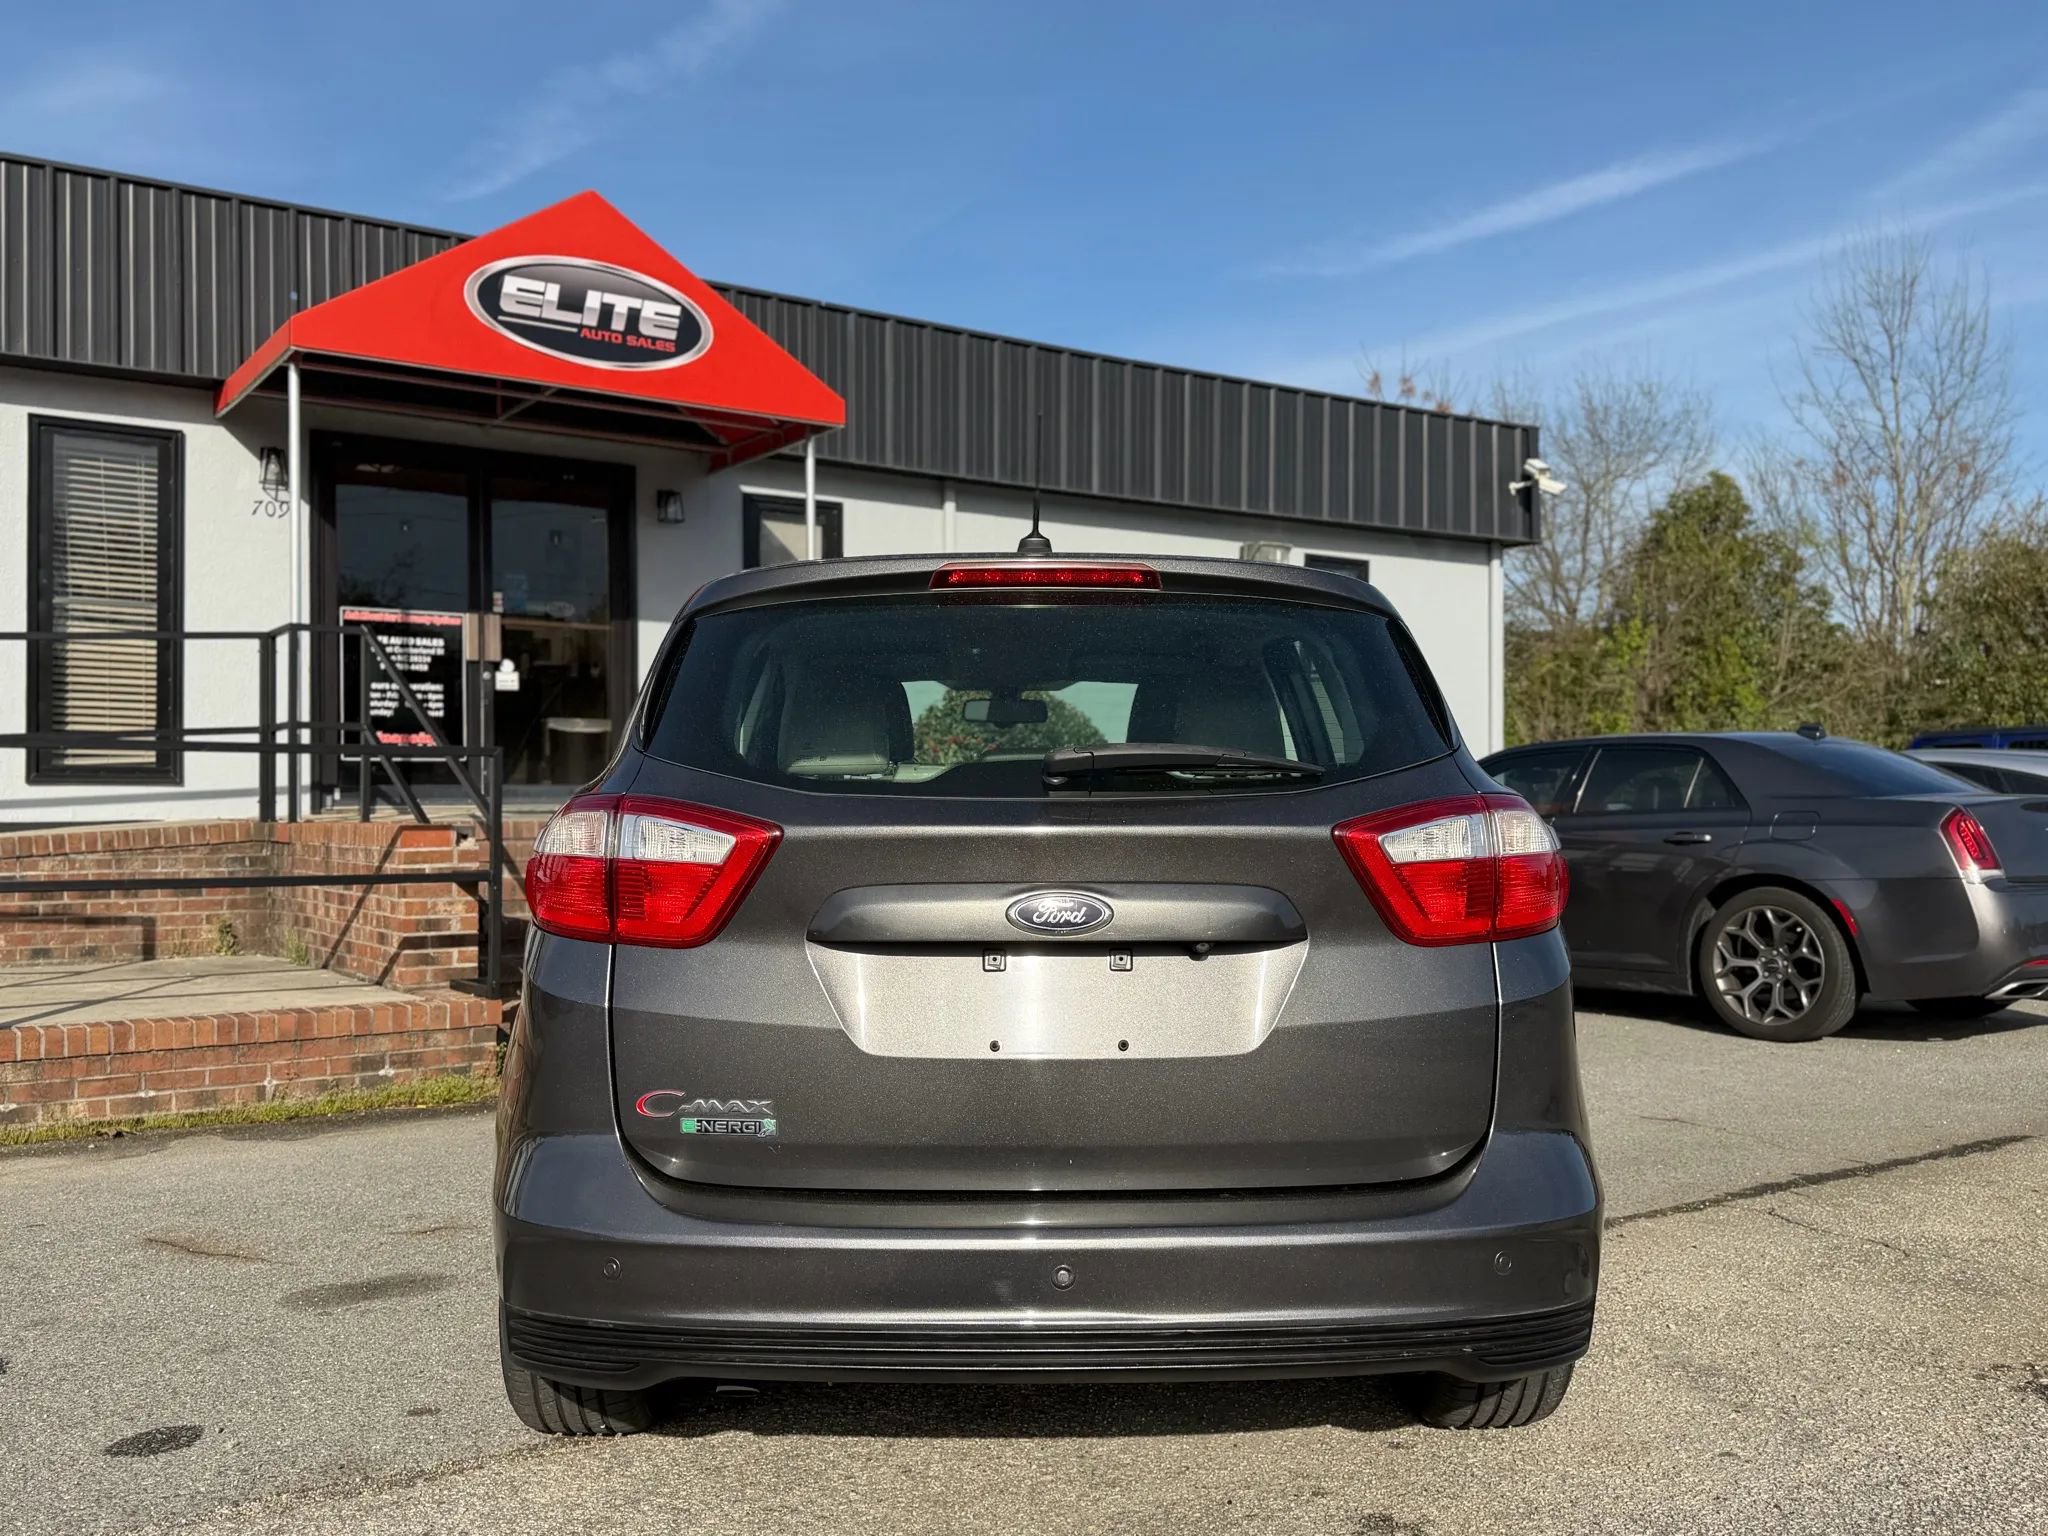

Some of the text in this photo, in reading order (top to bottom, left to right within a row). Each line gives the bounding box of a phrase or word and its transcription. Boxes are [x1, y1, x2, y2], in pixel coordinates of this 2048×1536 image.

[499, 274, 682, 340] ELITE
[580, 327, 676, 353] AUTO SALES
[252, 500, 290, 518] 709
[1033, 900, 1087, 924] Ford
[681, 1119, 761, 1134] ENERGI
